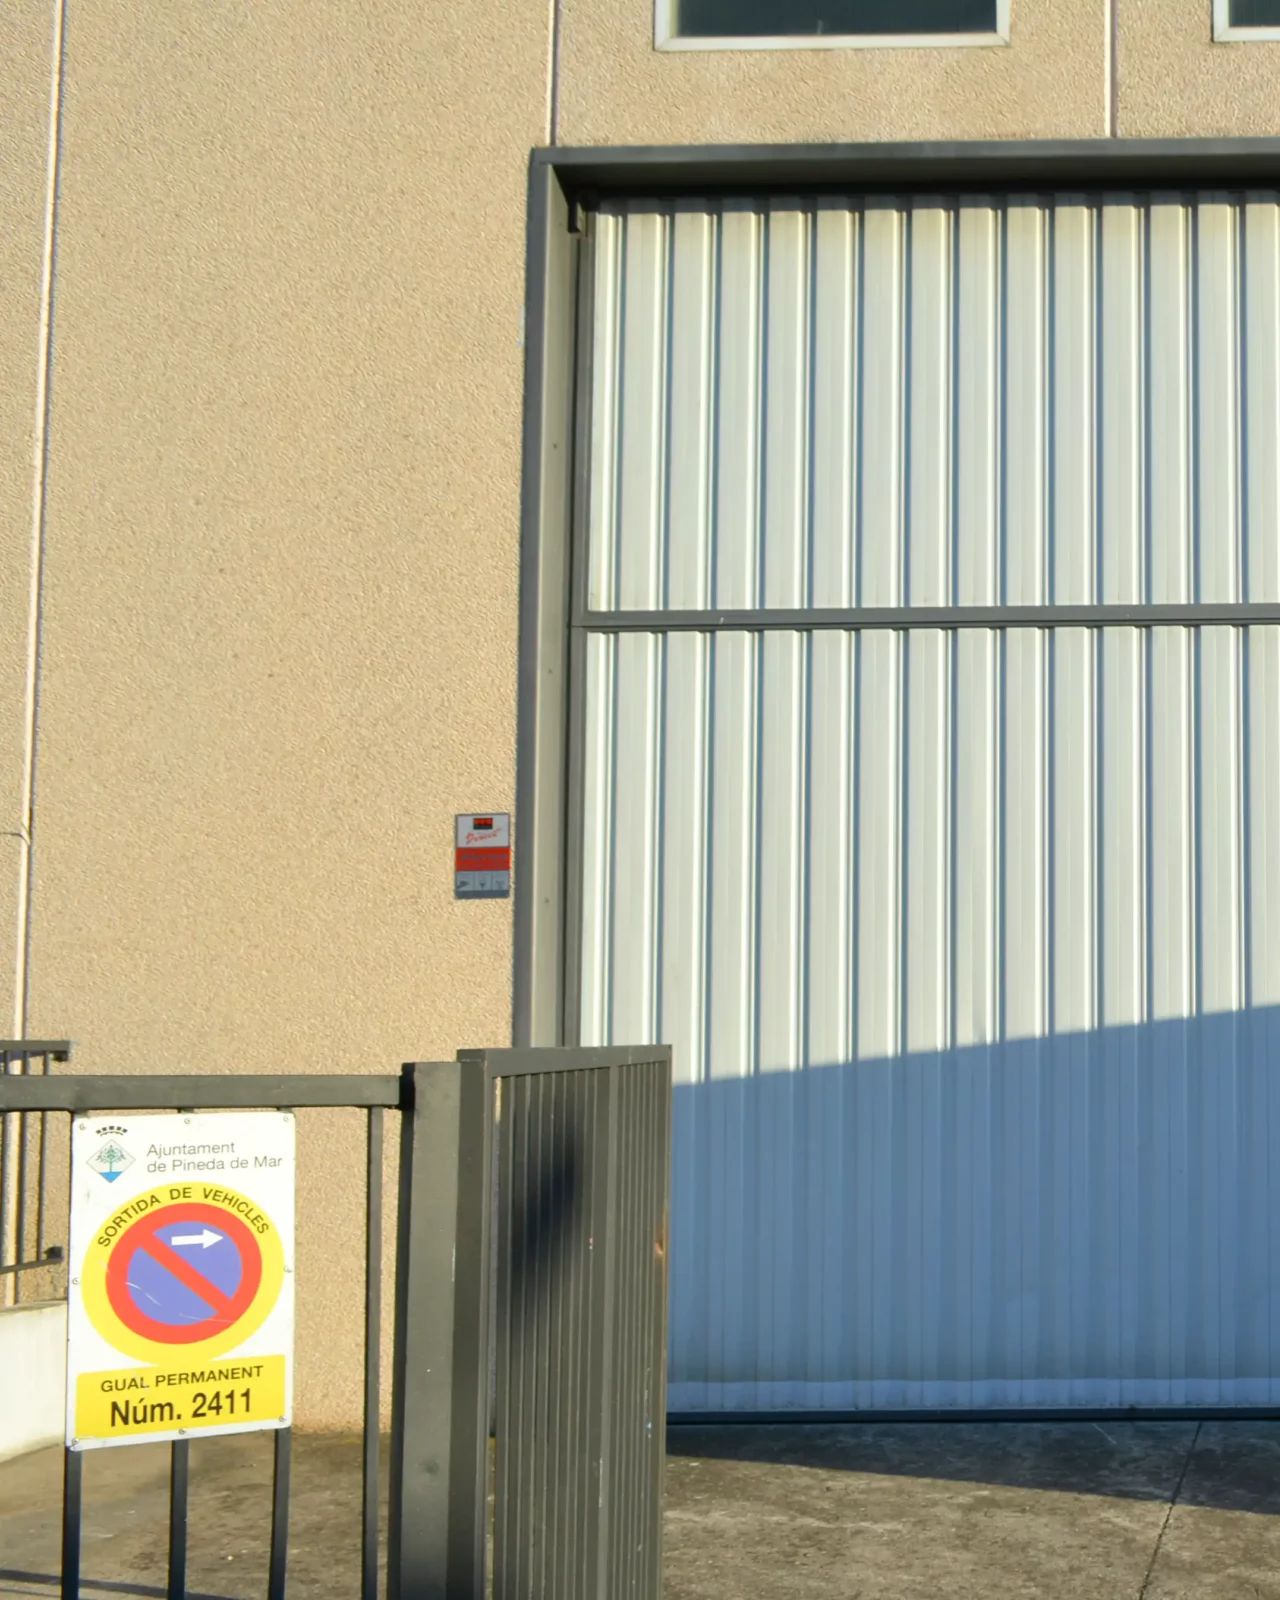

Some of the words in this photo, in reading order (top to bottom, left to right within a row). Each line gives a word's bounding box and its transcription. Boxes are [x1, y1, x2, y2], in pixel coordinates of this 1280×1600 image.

[146, 1160, 167, 1173] de
[172, 1158, 225, 1172] Pineda
[230, 1156, 249, 1170] de
[254, 1155, 283, 1169] Mar
[147, 1141, 236, 1159] Ajuntament
[97, 1194, 161, 1247] SORTIDA
[169, 1186, 193, 1201] DE
[202, 1187, 270, 1234] VEHICLES
[100, 1376, 150, 1393] GUAL
[155, 1365, 264, 1388] PERMANENT
[110, 1397, 182, 1428] Núm.
[191, 1387, 251, 1419] 2411
